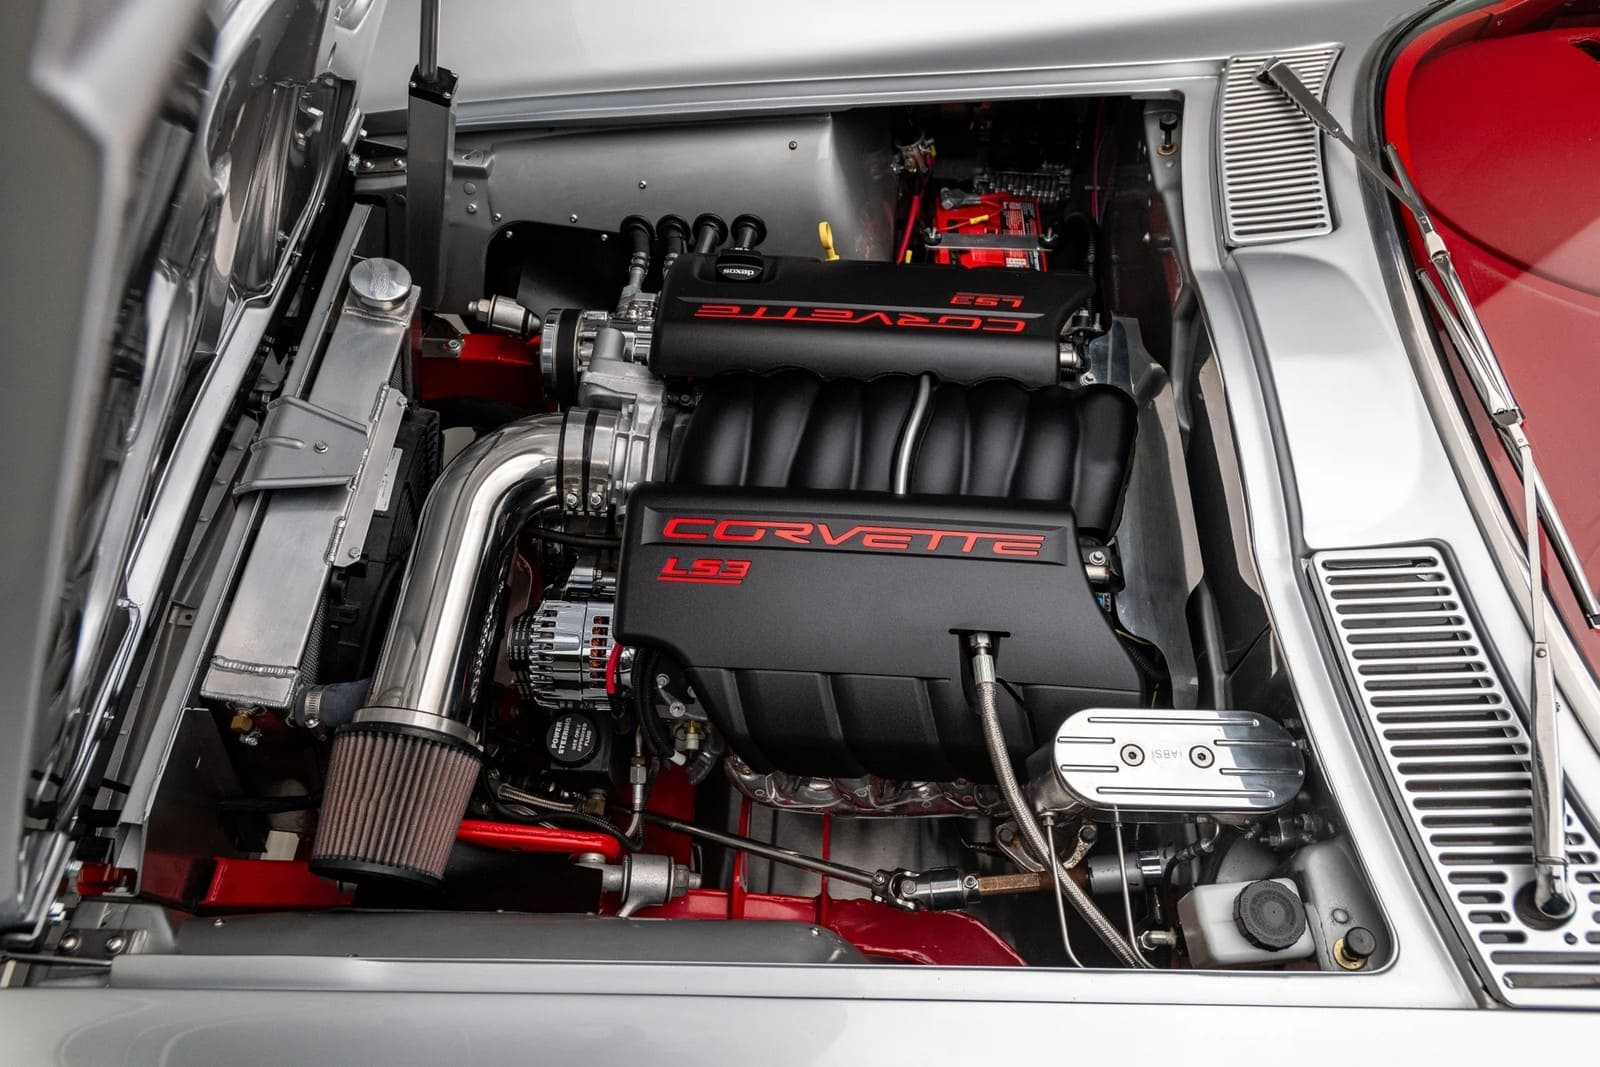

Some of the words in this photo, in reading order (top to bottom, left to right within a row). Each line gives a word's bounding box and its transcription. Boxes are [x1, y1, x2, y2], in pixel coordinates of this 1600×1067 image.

[722, 267, 754, 276] dexos
[950, 294, 1024, 308] LS3
[694, 304, 1026, 333] CORVETTE
[663, 517, 1046, 557] CORVETTE
[660, 557, 752, 580] LS3
[551, 721, 562, 749] POWER
[558, 717, 571, 754] STEERING
